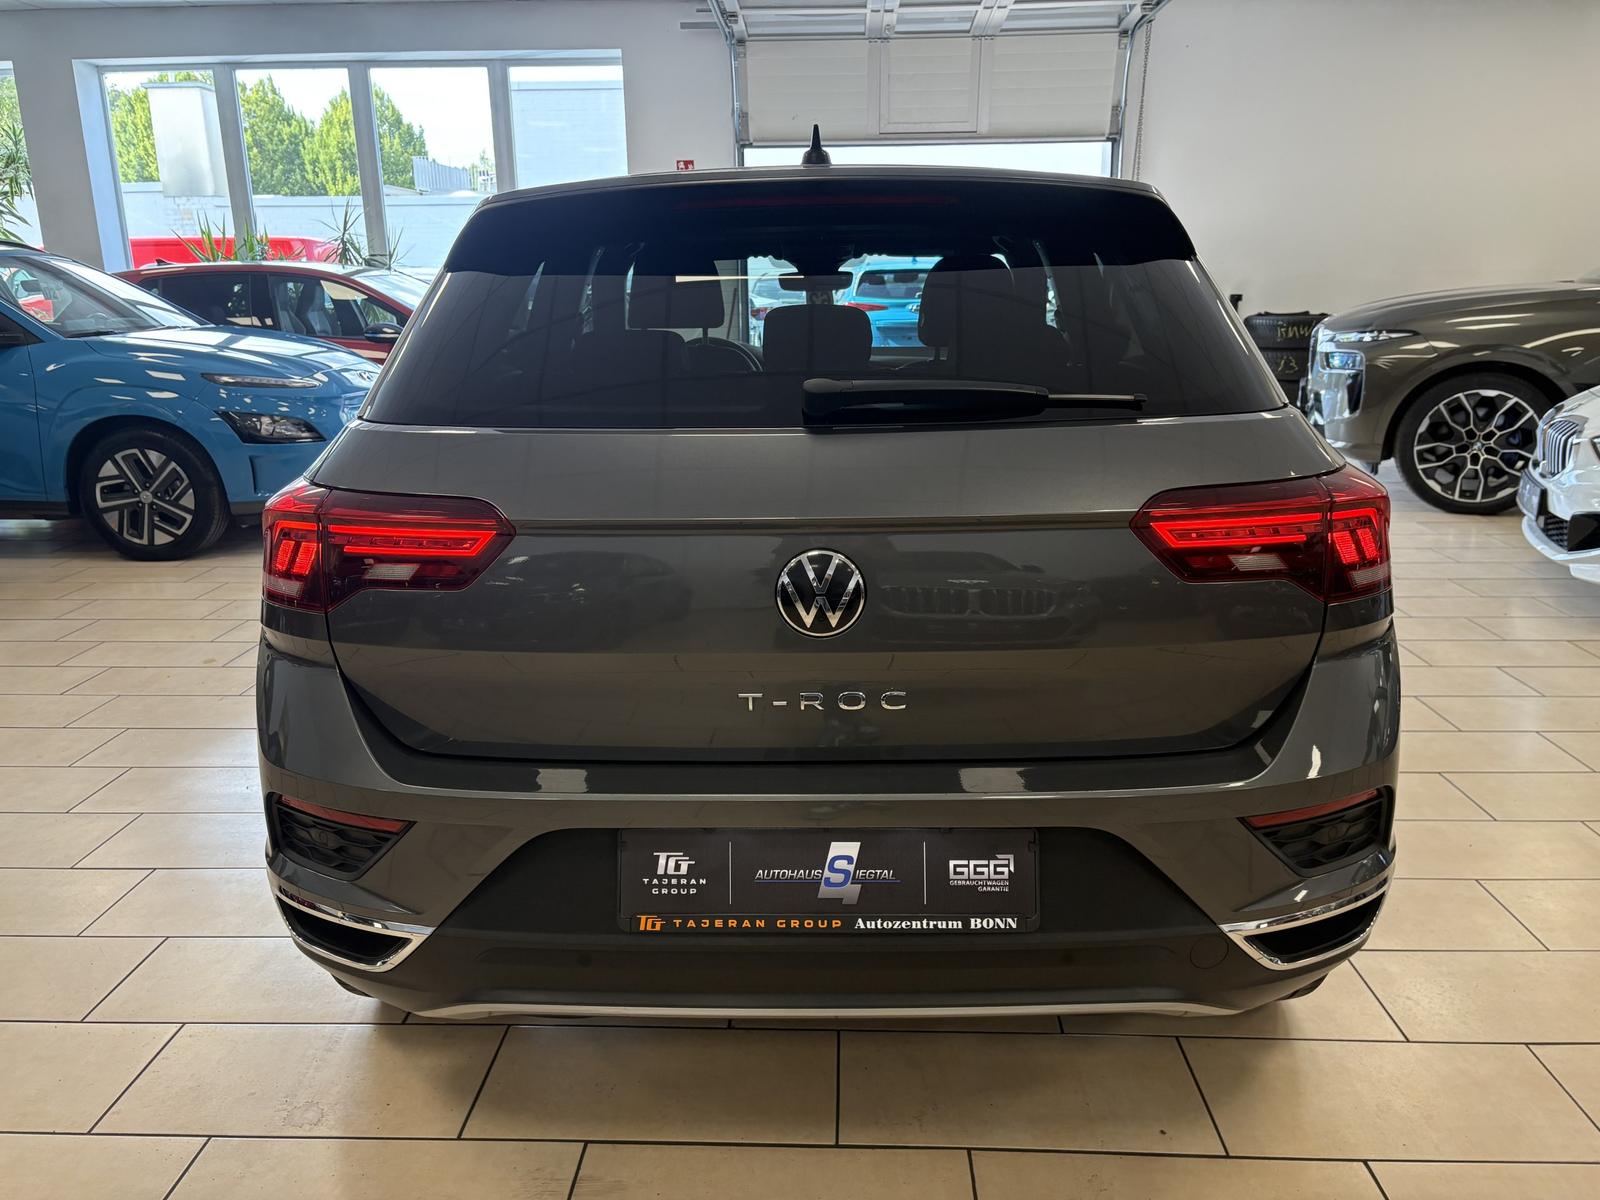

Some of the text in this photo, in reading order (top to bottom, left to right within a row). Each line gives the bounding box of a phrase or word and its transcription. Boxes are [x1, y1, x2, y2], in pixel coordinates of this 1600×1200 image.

[779, 551, 866, 636] VW
[738, 691, 907, 711] T-ROC
[755, 869, 822, 880] AUTOHAUS
[949, 860, 1010, 879] GGG
[673, 919, 766, 928] TAJERAN
[776, 919, 842, 928] GROUP
[854, 917, 963, 929] Autozentrum
[970, 917, 1018, 929] BONN
